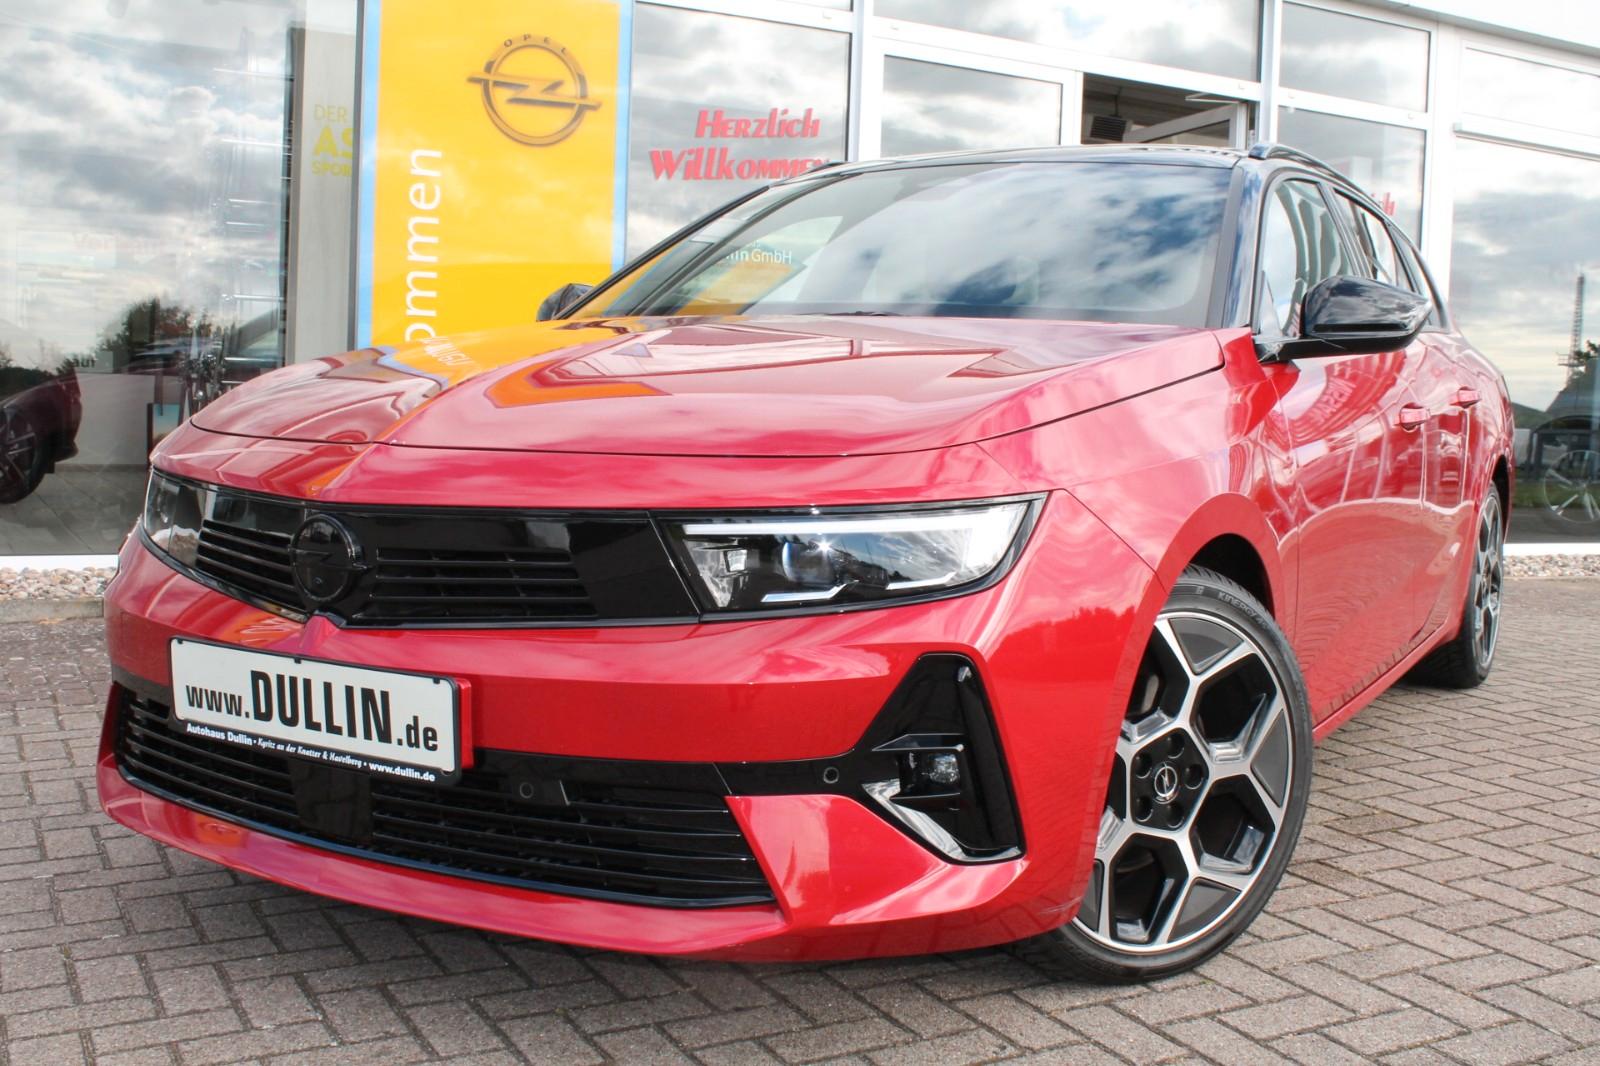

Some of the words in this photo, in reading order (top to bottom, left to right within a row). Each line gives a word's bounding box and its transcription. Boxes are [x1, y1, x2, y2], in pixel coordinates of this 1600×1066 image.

[503, 33, 567, 55] OPEL
[313, 104, 348, 123] DER
[751, 248, 792, 265] GmbH
[1217, 590, 1257, 617] KINERGY
[185, 669, 438, 752] www.DULLIN.de
[186, 723, 226, 741] Autohaus
[227, 731, 253, 746] Dullin
[258, 737, 276, 749] Kyritz
[285, 743, 296, 753] der
[297, 745, 322, 759] Knatter
[322, 750, 329, 760] &
[329, 751, 362, 769] Havelberg
[368, 762, 436, 782] www.dullin.de
